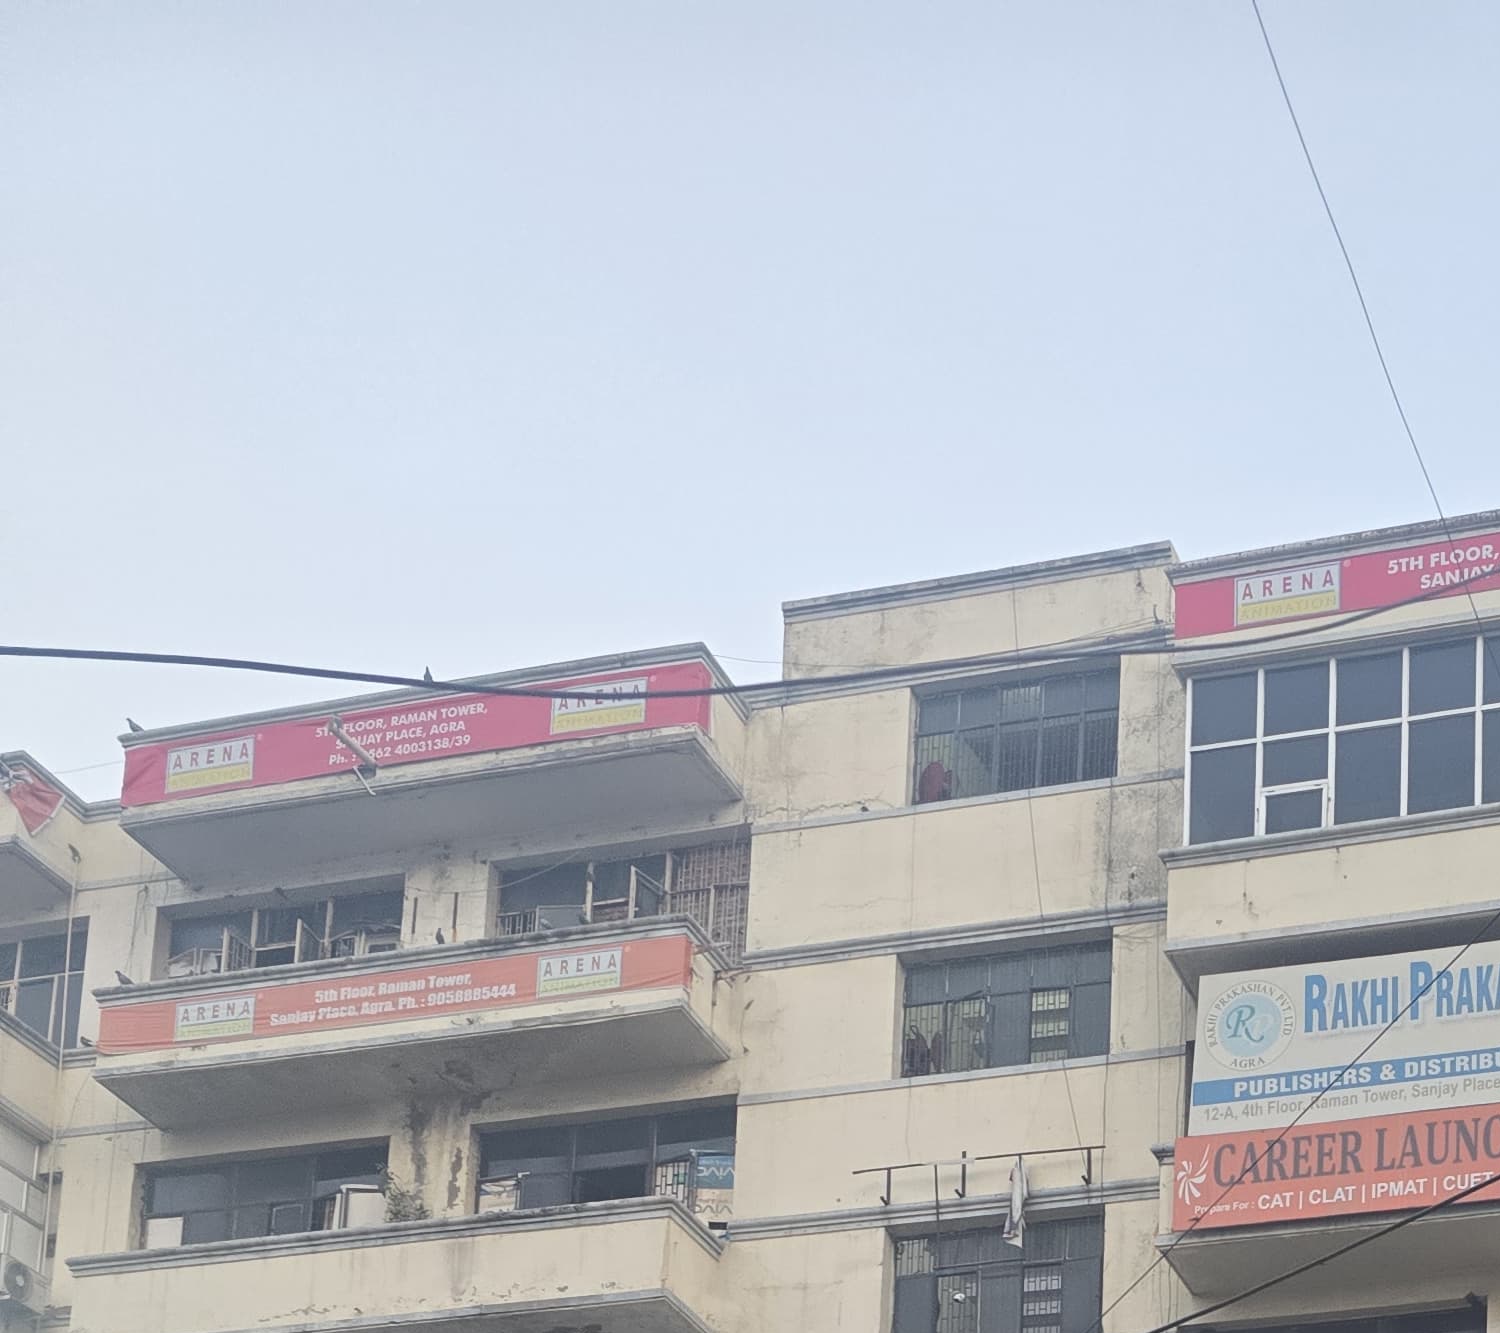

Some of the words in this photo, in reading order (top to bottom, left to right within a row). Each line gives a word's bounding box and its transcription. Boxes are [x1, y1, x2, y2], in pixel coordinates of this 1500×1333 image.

[1387, 556, 1423, 574] 5TH
[1430, 545, 1499, 570] FLOOR,
[1242, 570, 1334, 601] ARENA
[1420, 561, 1494, 589] SANJAY
[391, 710, 437, 727] RAMAN
[441, 703, 487, 718] TOWER,
[386, 727, 426, 743] PLACE,
[430, 721, 465, 735] AGRA
[173, 742, 249, 770] ARENA
[544, 954, 617, 977] ARENA
[315, 990, 338, 1003] 5th
[379, 981, 425, 995] Raman
[1304, 974, 1399, 1033] RAKHI
[181, 1000, 250, 1022] ARENA
[270, 1008, 315, 1026] Sanjay
[1234, 1068, 1372, 1098] PUBLISHERS
[1379, 1063, 1396, 1081] &
[1242, 1104, 1263, 1118] 4th
[1411, 1078, 1463, 1099] Sanjay
[1213, 1131, 1363, 1188] CAREER
[1258, 1191, 1294, 1210] CAT
[1309, 1185, 1357, 1204] CLAT
[1372, 1178, 1428, 1199] IPMAT
